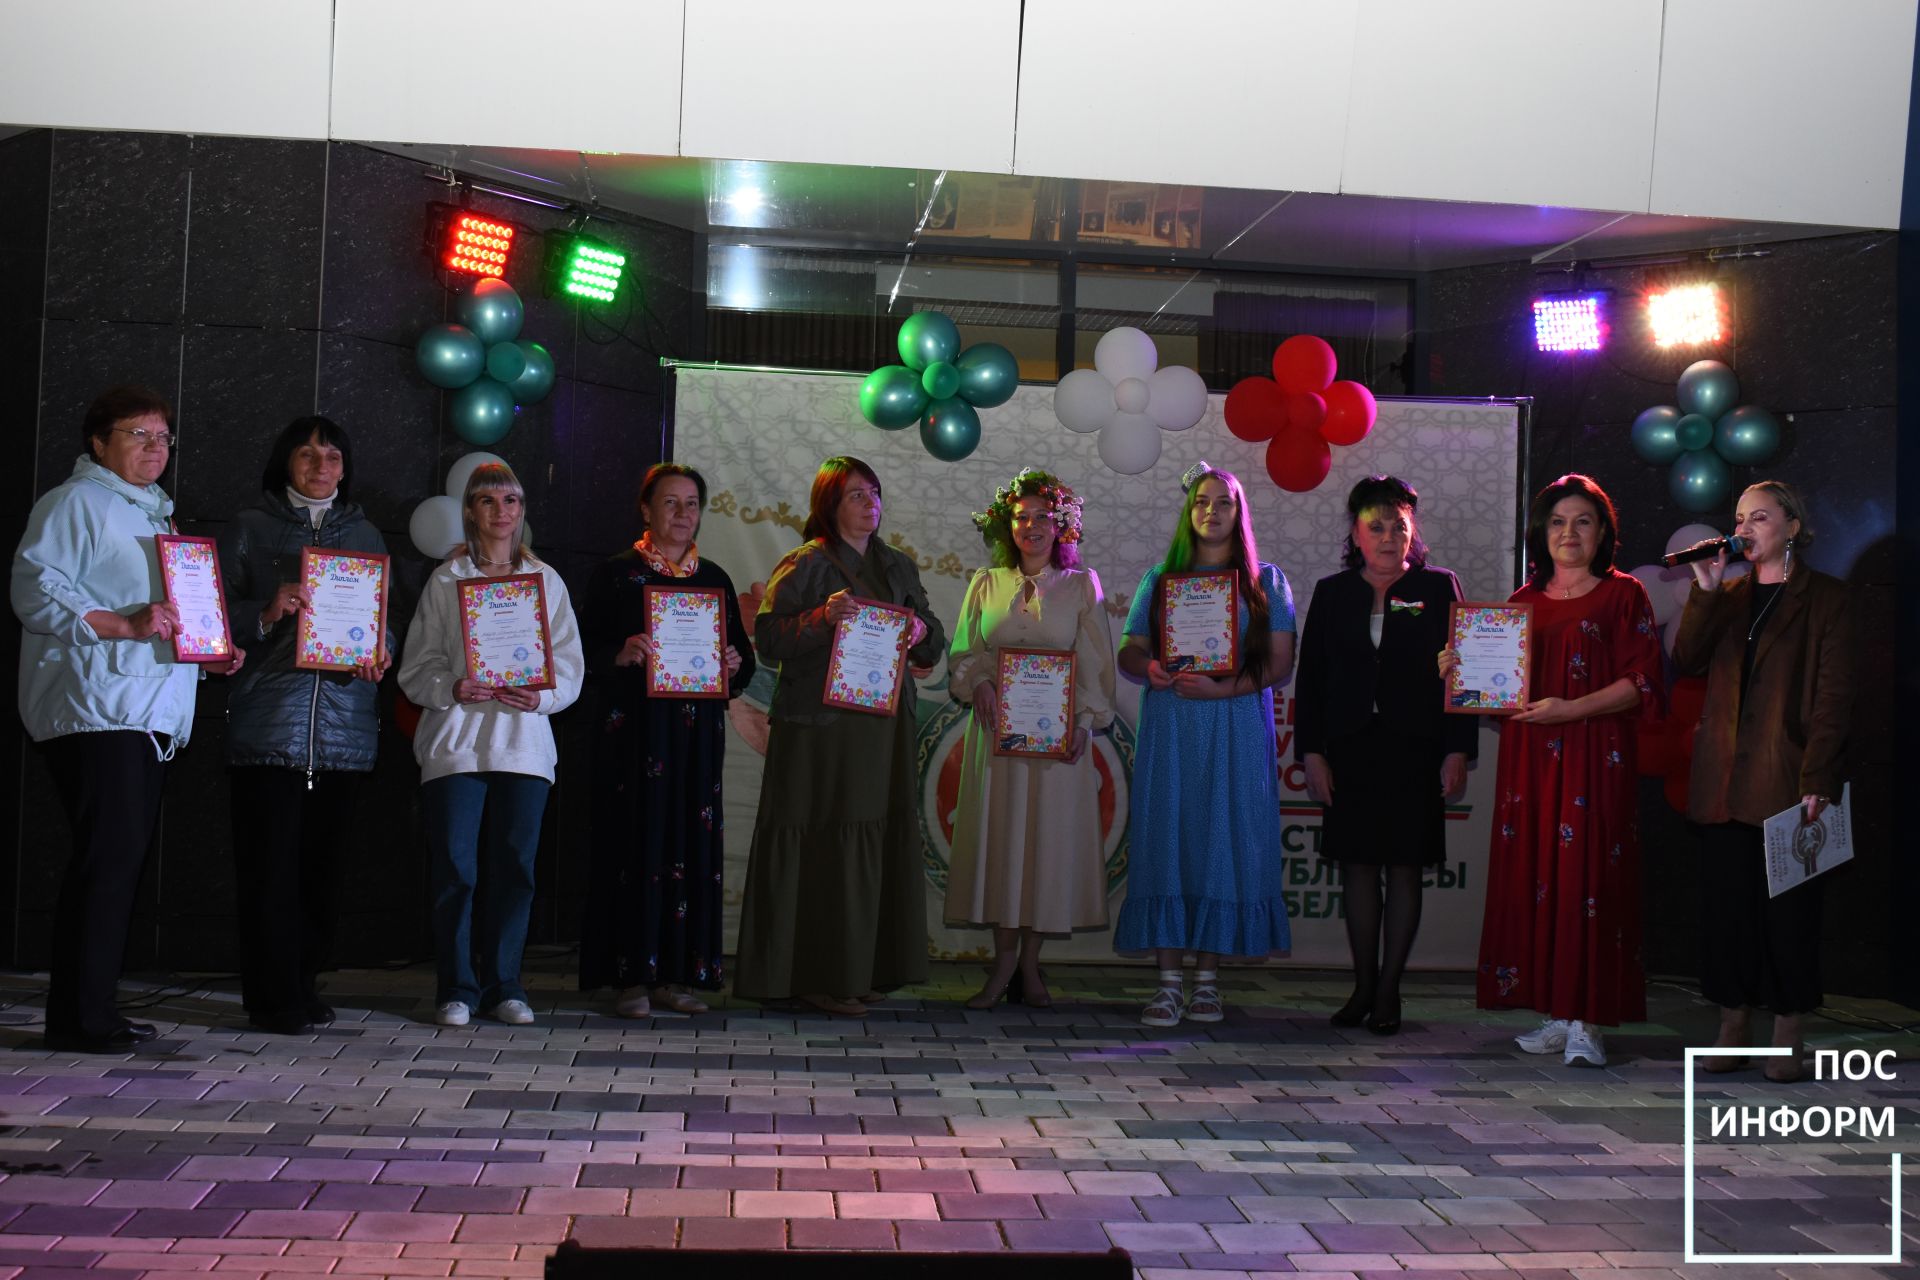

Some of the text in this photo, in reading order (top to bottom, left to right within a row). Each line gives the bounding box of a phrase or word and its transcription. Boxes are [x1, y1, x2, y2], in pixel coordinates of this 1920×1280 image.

[329, 574, 360, 583] Диплом
[488, 601, 518, 609] Диплом
[672, 608, 699, 617] Диплом
[1477, 625, 1505, 633] Диплом
[1023, 671, 1050, 679] Диплом
